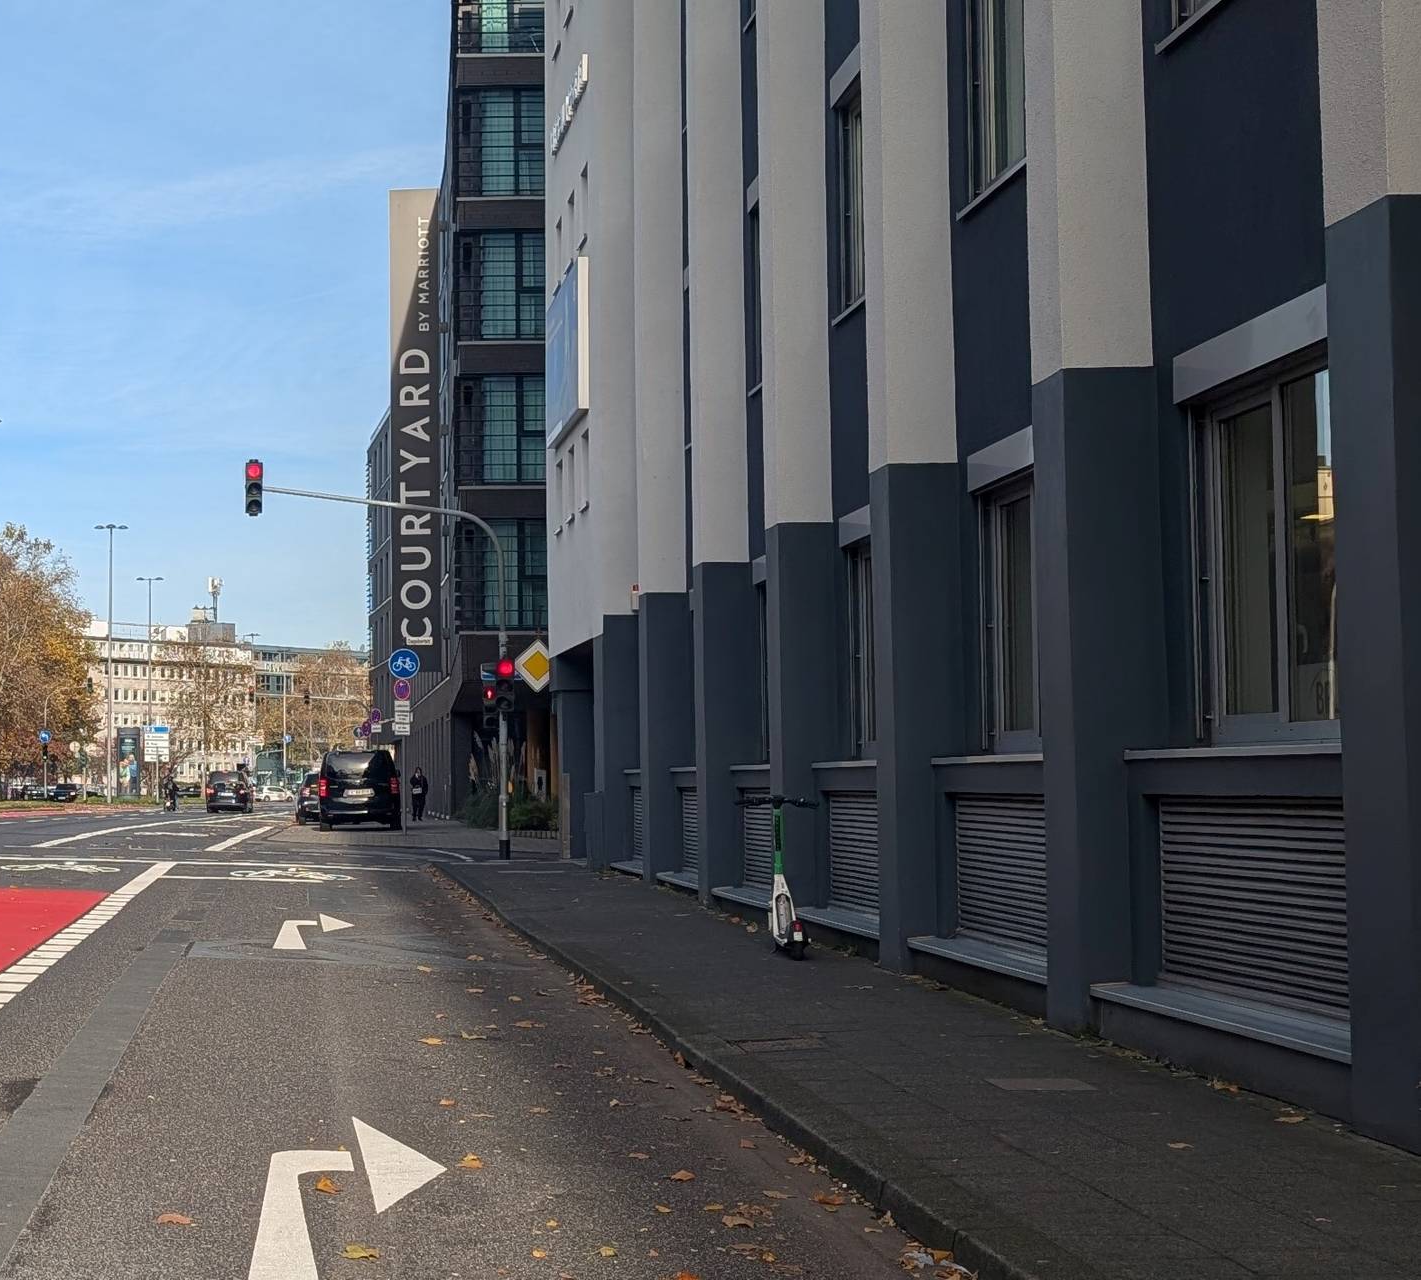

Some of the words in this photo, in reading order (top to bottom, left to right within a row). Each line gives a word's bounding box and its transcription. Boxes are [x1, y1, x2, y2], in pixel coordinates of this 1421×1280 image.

[418, 216, 430, 304] MARRIOTT
[418, 312, 430, 332] BY
[400, 349, 432, 638] COURTYARD
